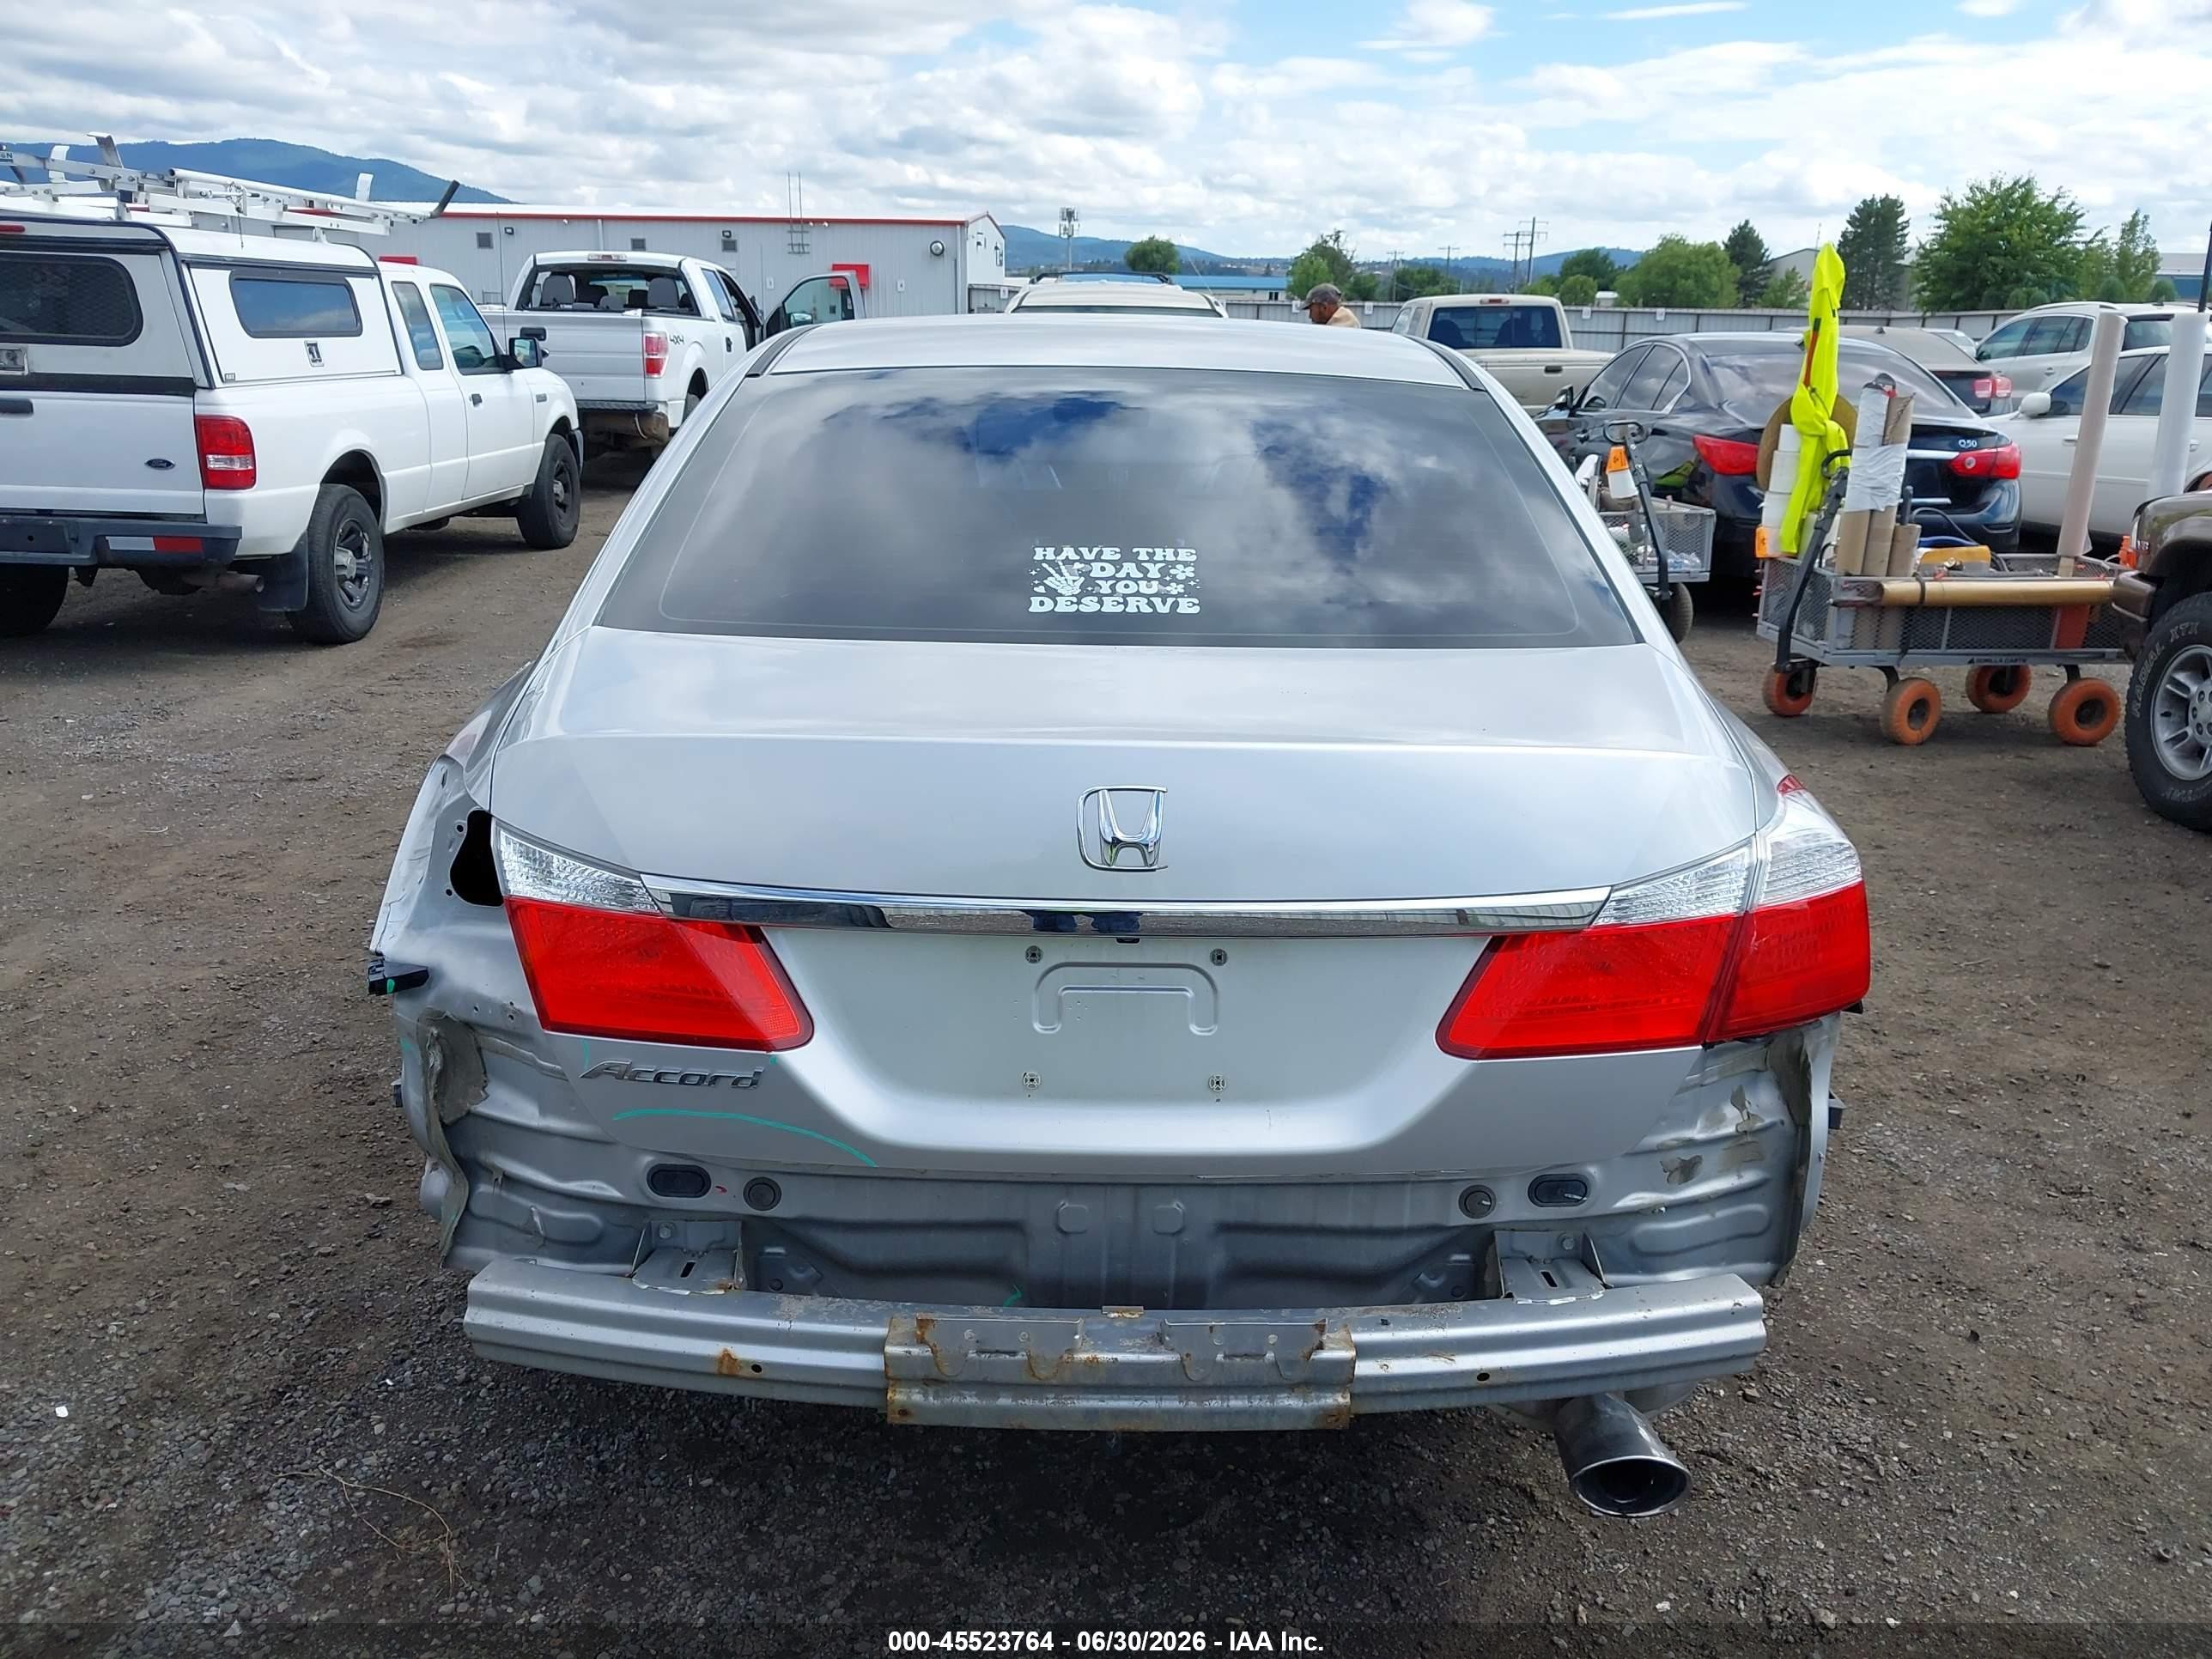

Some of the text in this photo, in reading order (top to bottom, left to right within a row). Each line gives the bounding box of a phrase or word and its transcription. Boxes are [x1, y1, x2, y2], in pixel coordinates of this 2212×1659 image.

[1958, 439, 1978, 448] Q50
[1033, 547, 1197, 562] HAVE THE
[1089, 562, 1166, 578] DAY
[1095, 580, 1159, 594] YOU
[1029, 596, 1200, 613] DESERVE
[2131, 641, 2165, 718] RADIAL
[579, 1059, 766, 1089] Accord
